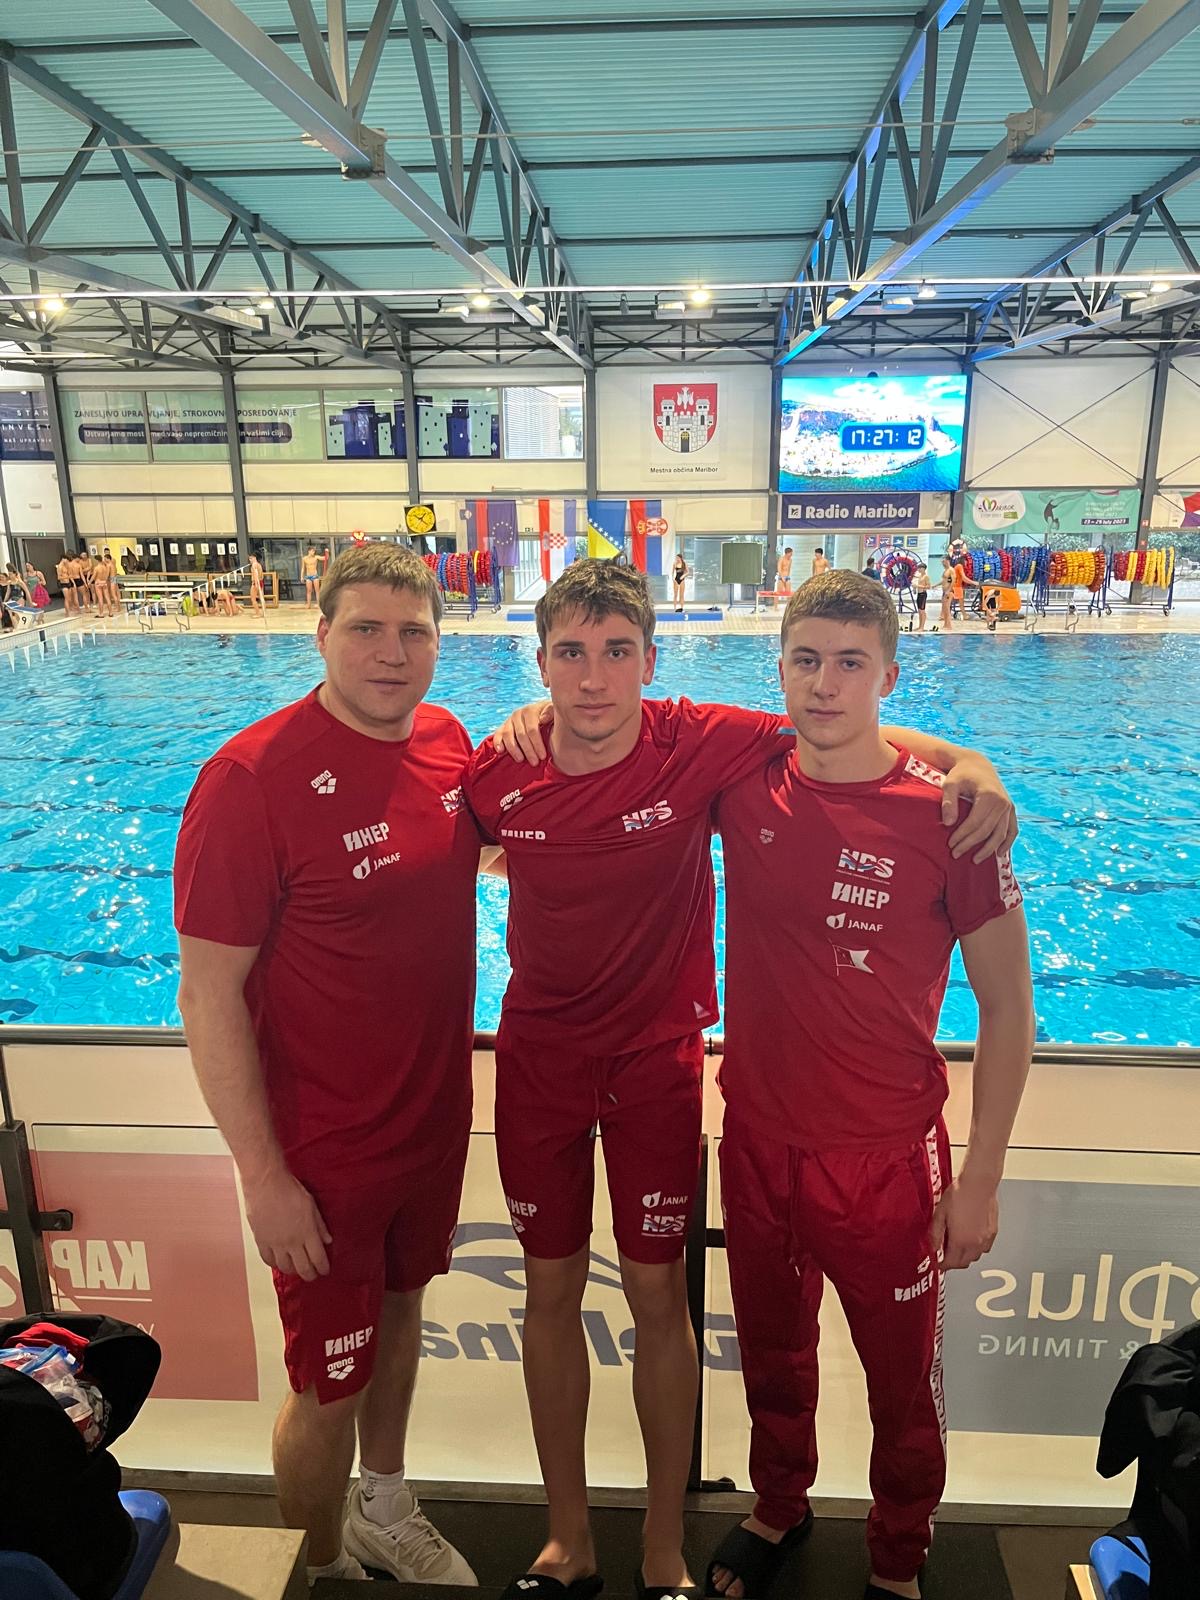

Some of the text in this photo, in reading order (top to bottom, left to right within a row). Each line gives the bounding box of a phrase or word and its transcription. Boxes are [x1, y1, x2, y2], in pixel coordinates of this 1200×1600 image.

[74, 410, 119, 418] ZANESLJIVO
[182, 409, 225, 417] STROKOVN
[238, 409, 297, 417] POSREDOVANJE
[1, 423, 51, 431] INVEST
[126, 430, 145, 438] most
[184, 430, 228, 439] nepremičnin
[907, 428, 922, 446] 12
[805, 503, 914, 519] Radio Maribor
[21, 616, 28, 625] 9
[310, 769, 333, 790] arena
[499, 788, 521, 808] arena
[360, 822, 390, 847] HEP
[373, 852, 401, 871] JANAF
[850, 885, 890, 910] HEP
[847, 919, 884, 932] JANAF
[510, 1198, 538, 1218] HEP
[661, 1195, 689, 1206] JANAF
[343, 1325, 374, 1353] HEP
[327, 1356, 354, 1372] arena
